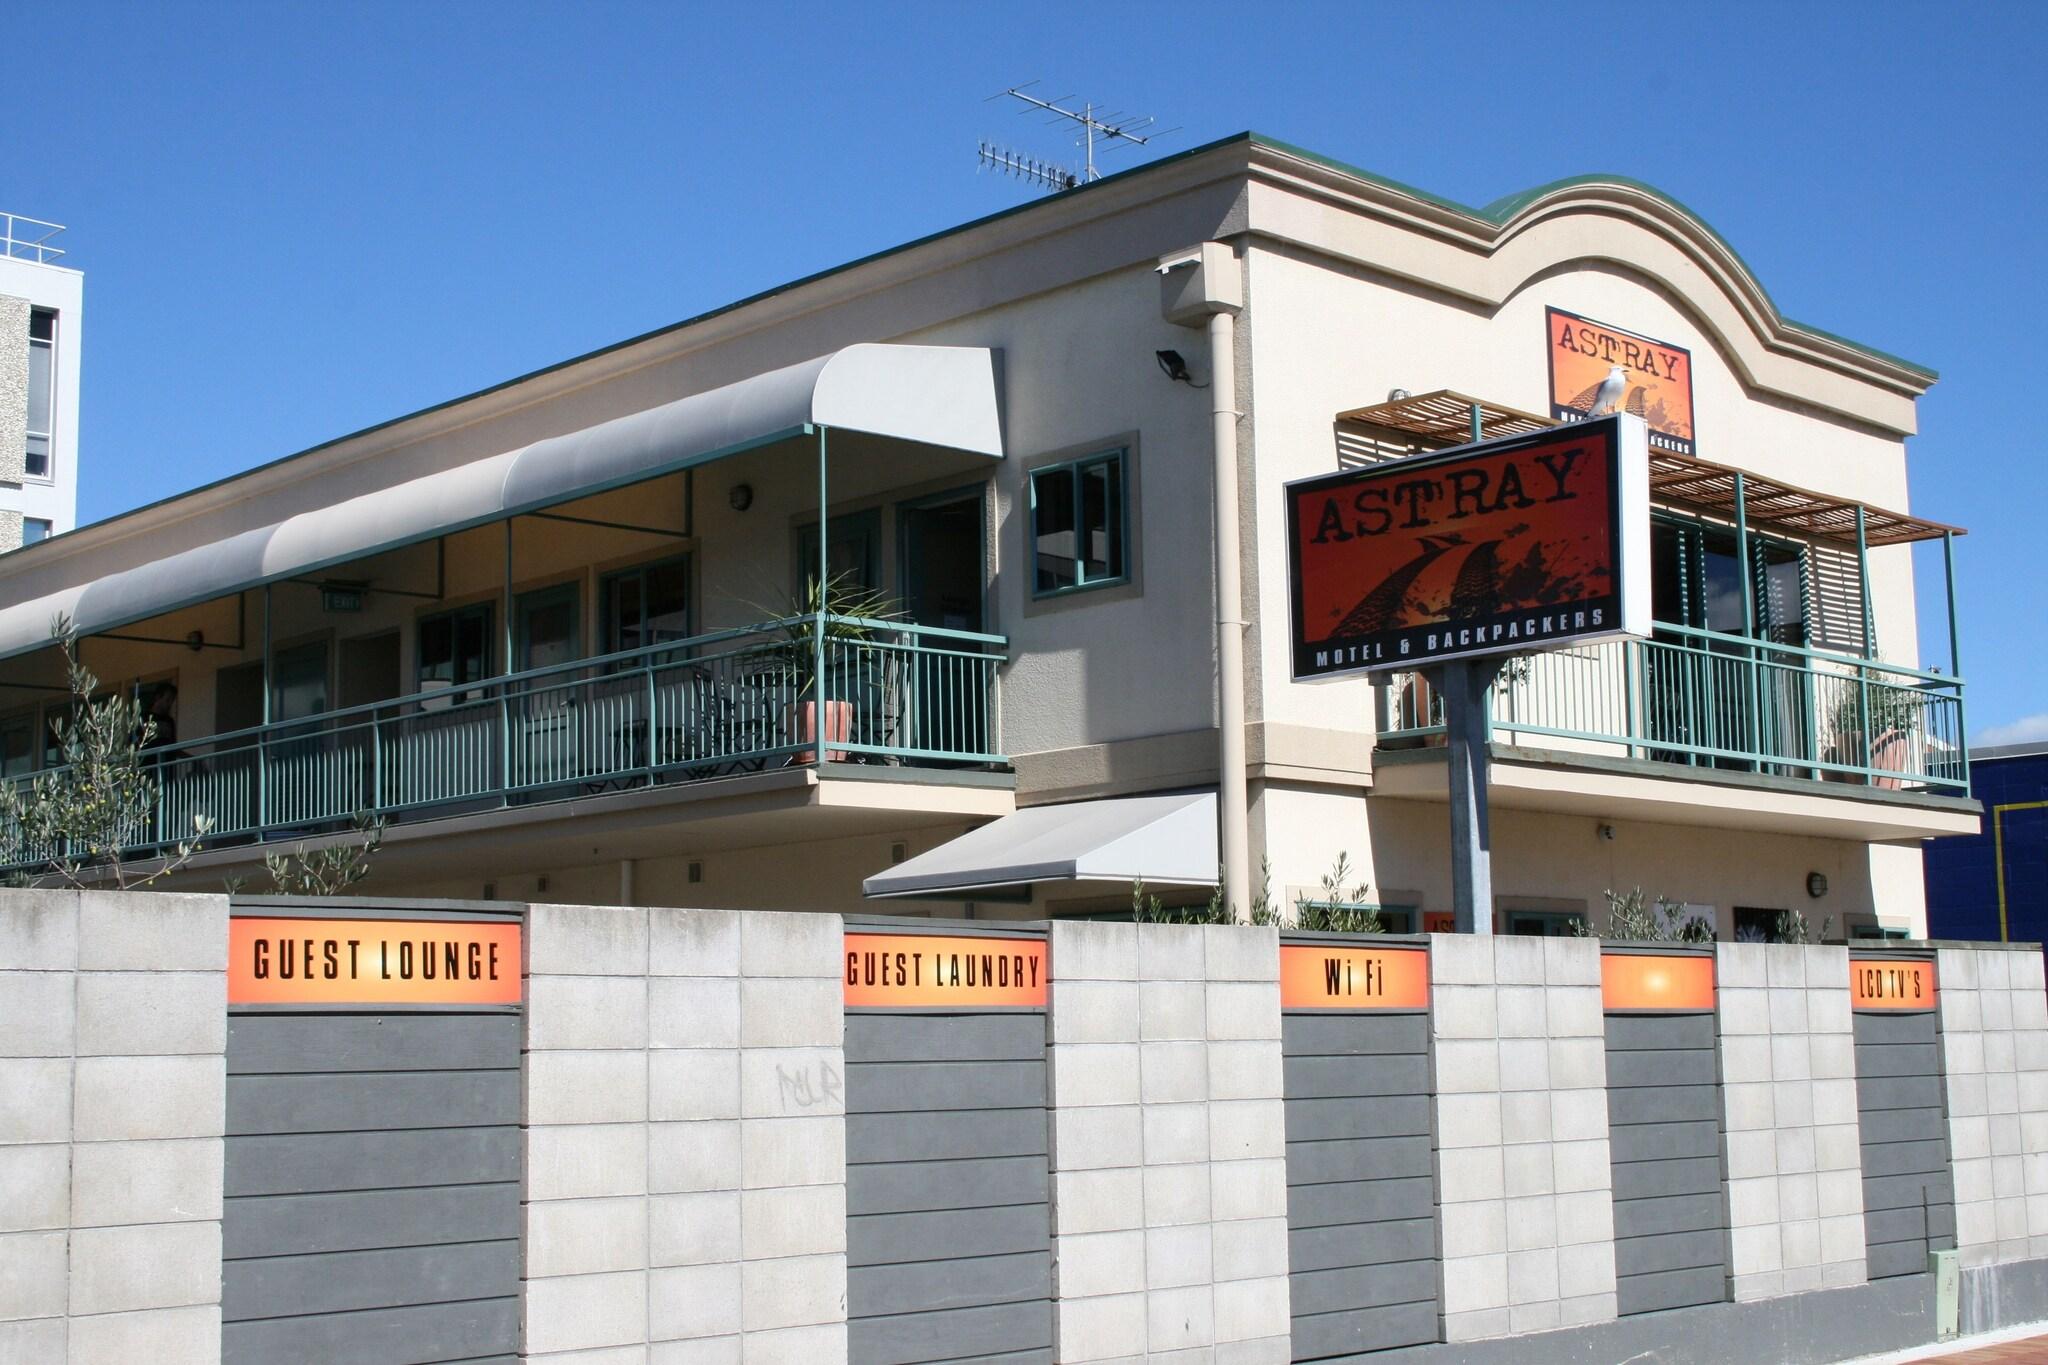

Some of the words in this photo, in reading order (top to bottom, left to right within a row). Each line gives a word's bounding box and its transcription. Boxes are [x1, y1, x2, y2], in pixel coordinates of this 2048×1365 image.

[1558, 323, 1679, 382] ASTRAY
[1650, 435, 1690, 454] ACKERS
[1310, 448, 1586, 545] ASTRAY
[1316, 642, 1383, 668] MOTEL
[1400, 638, 1410, 655] &
[1428, 608, 1603, 650] BACKPACKERS
[254, 939, 360, 980] GUEST
[381, 940, 498, 981] LOUNGE
[847, 952, 922, 986] GUEST
[936, 953, 1039, 988] LAUNDRY
[1325, 958, 1352, 996] Wi
[1366, 959, 1383, 996] Fi
[1859, 969, 1883, 998] LCD
[1889, 969, 1921, 998] TV'S
